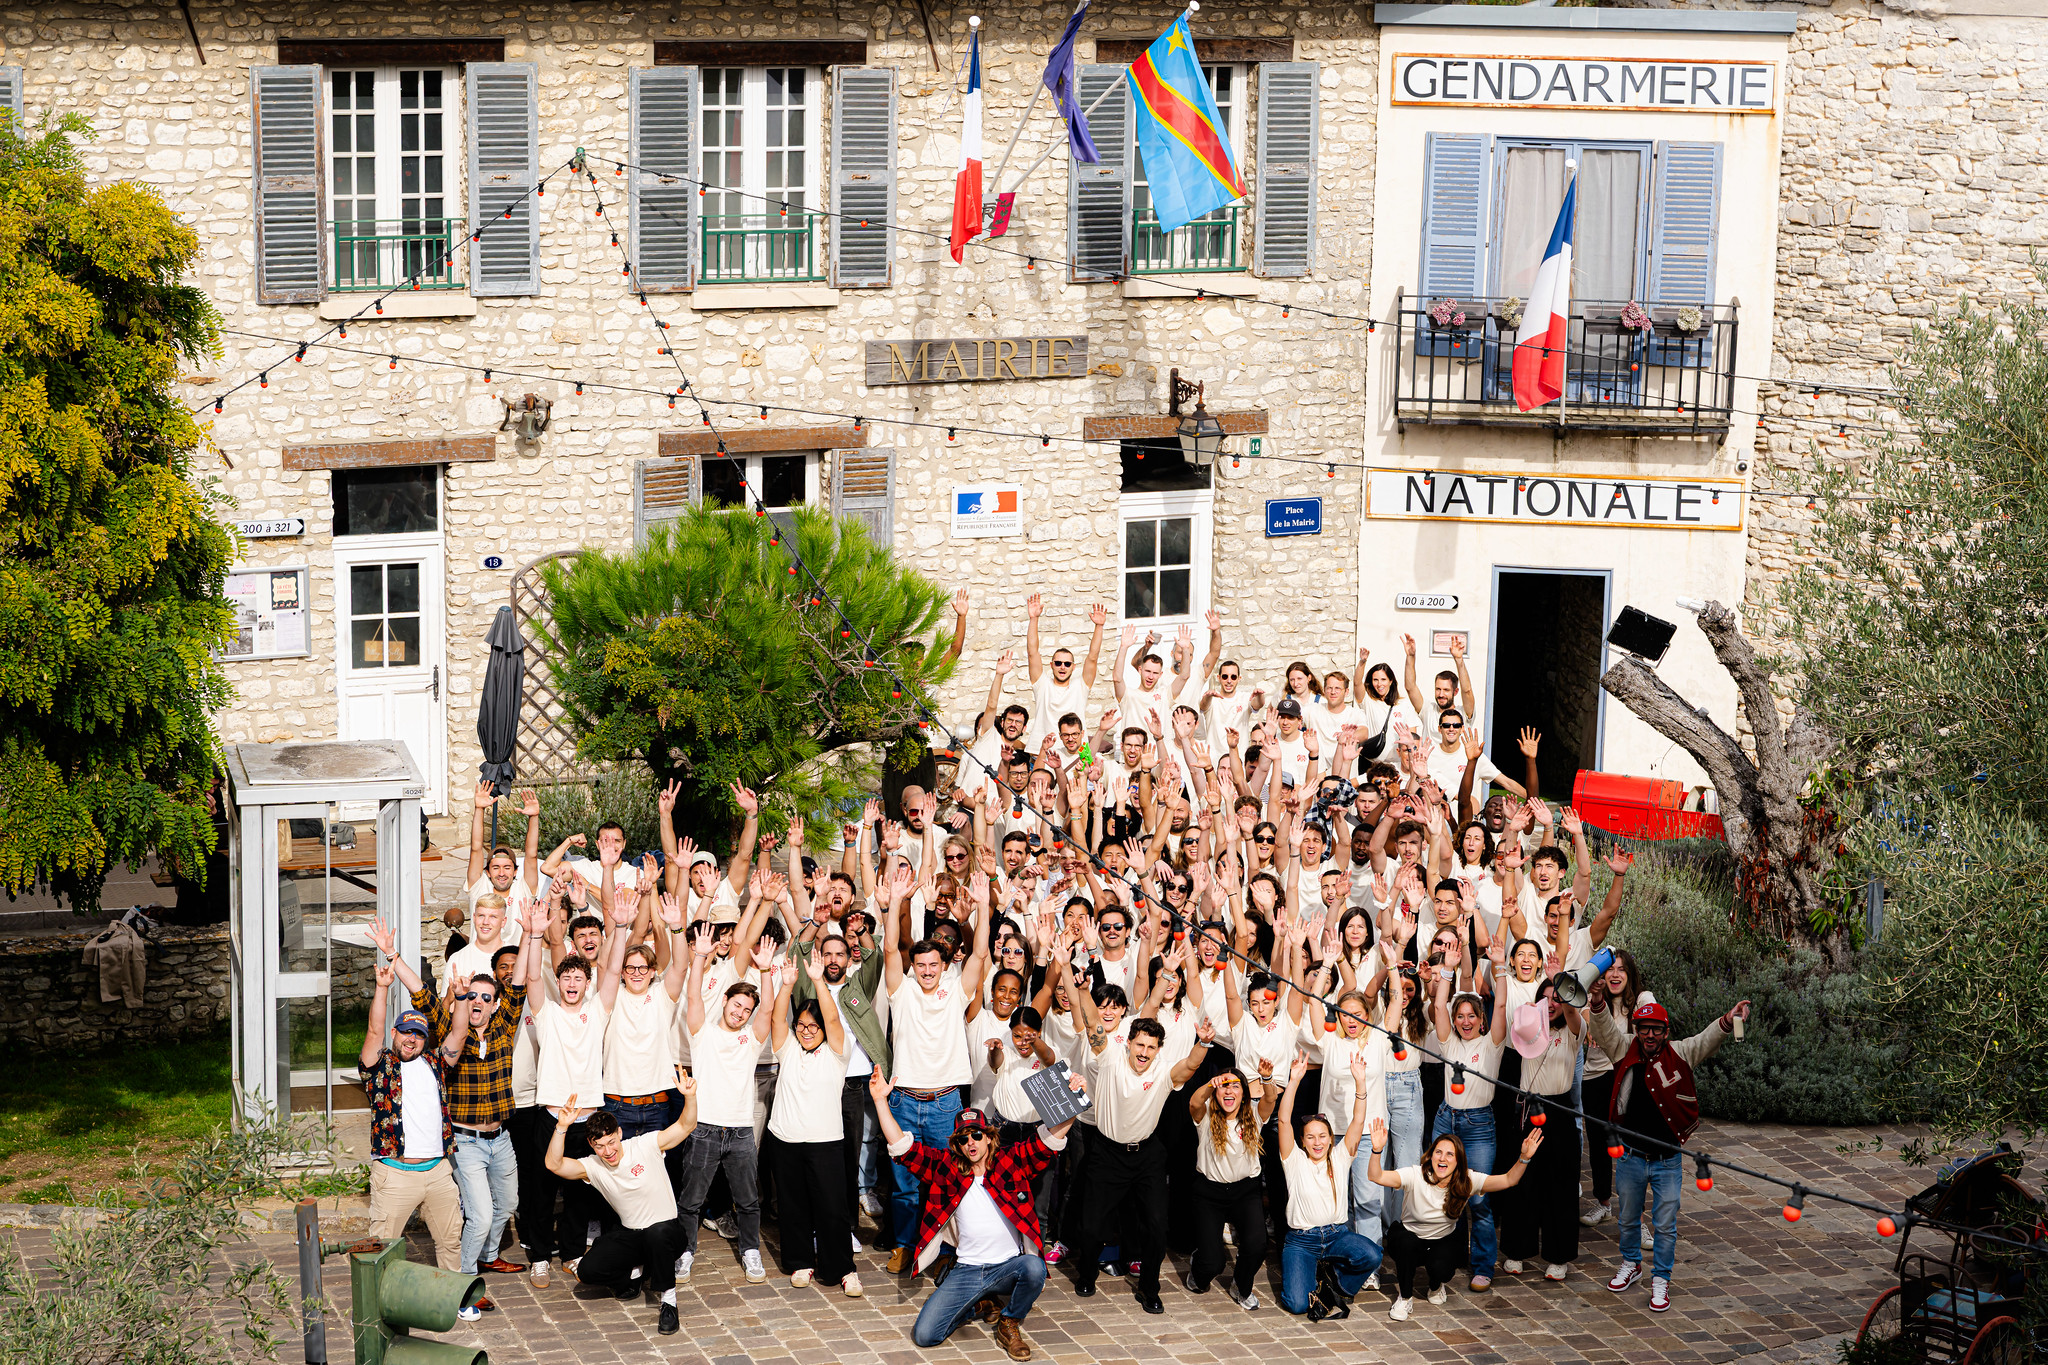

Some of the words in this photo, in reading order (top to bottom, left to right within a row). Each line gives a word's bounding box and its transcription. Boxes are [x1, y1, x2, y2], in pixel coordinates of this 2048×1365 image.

[1403, 58, 1768, 107] GENDARMERIE
[886, 337, 1076, 383] MAIRIE
[1251, 442, 1260, 452] 14
[1405, 475, 1703, 521] NATIONALE
[1285, 506, 1304, 514] Place
[242, 524, 262, 534] 300
[265, 523, 271, 533] à
[274, 522, 291, 532] 321
[1273, 520, 1283, 528] de
[1283, 519, 1291, 527] la
[1291, 518, 1315, 527] Mairie
[1401, 596, 1417, 606] 100
[1419, 597, 1425, 606] à
[1426, 597, 1445, 607] 200
[1652, 1061, 1682, 1088] L
